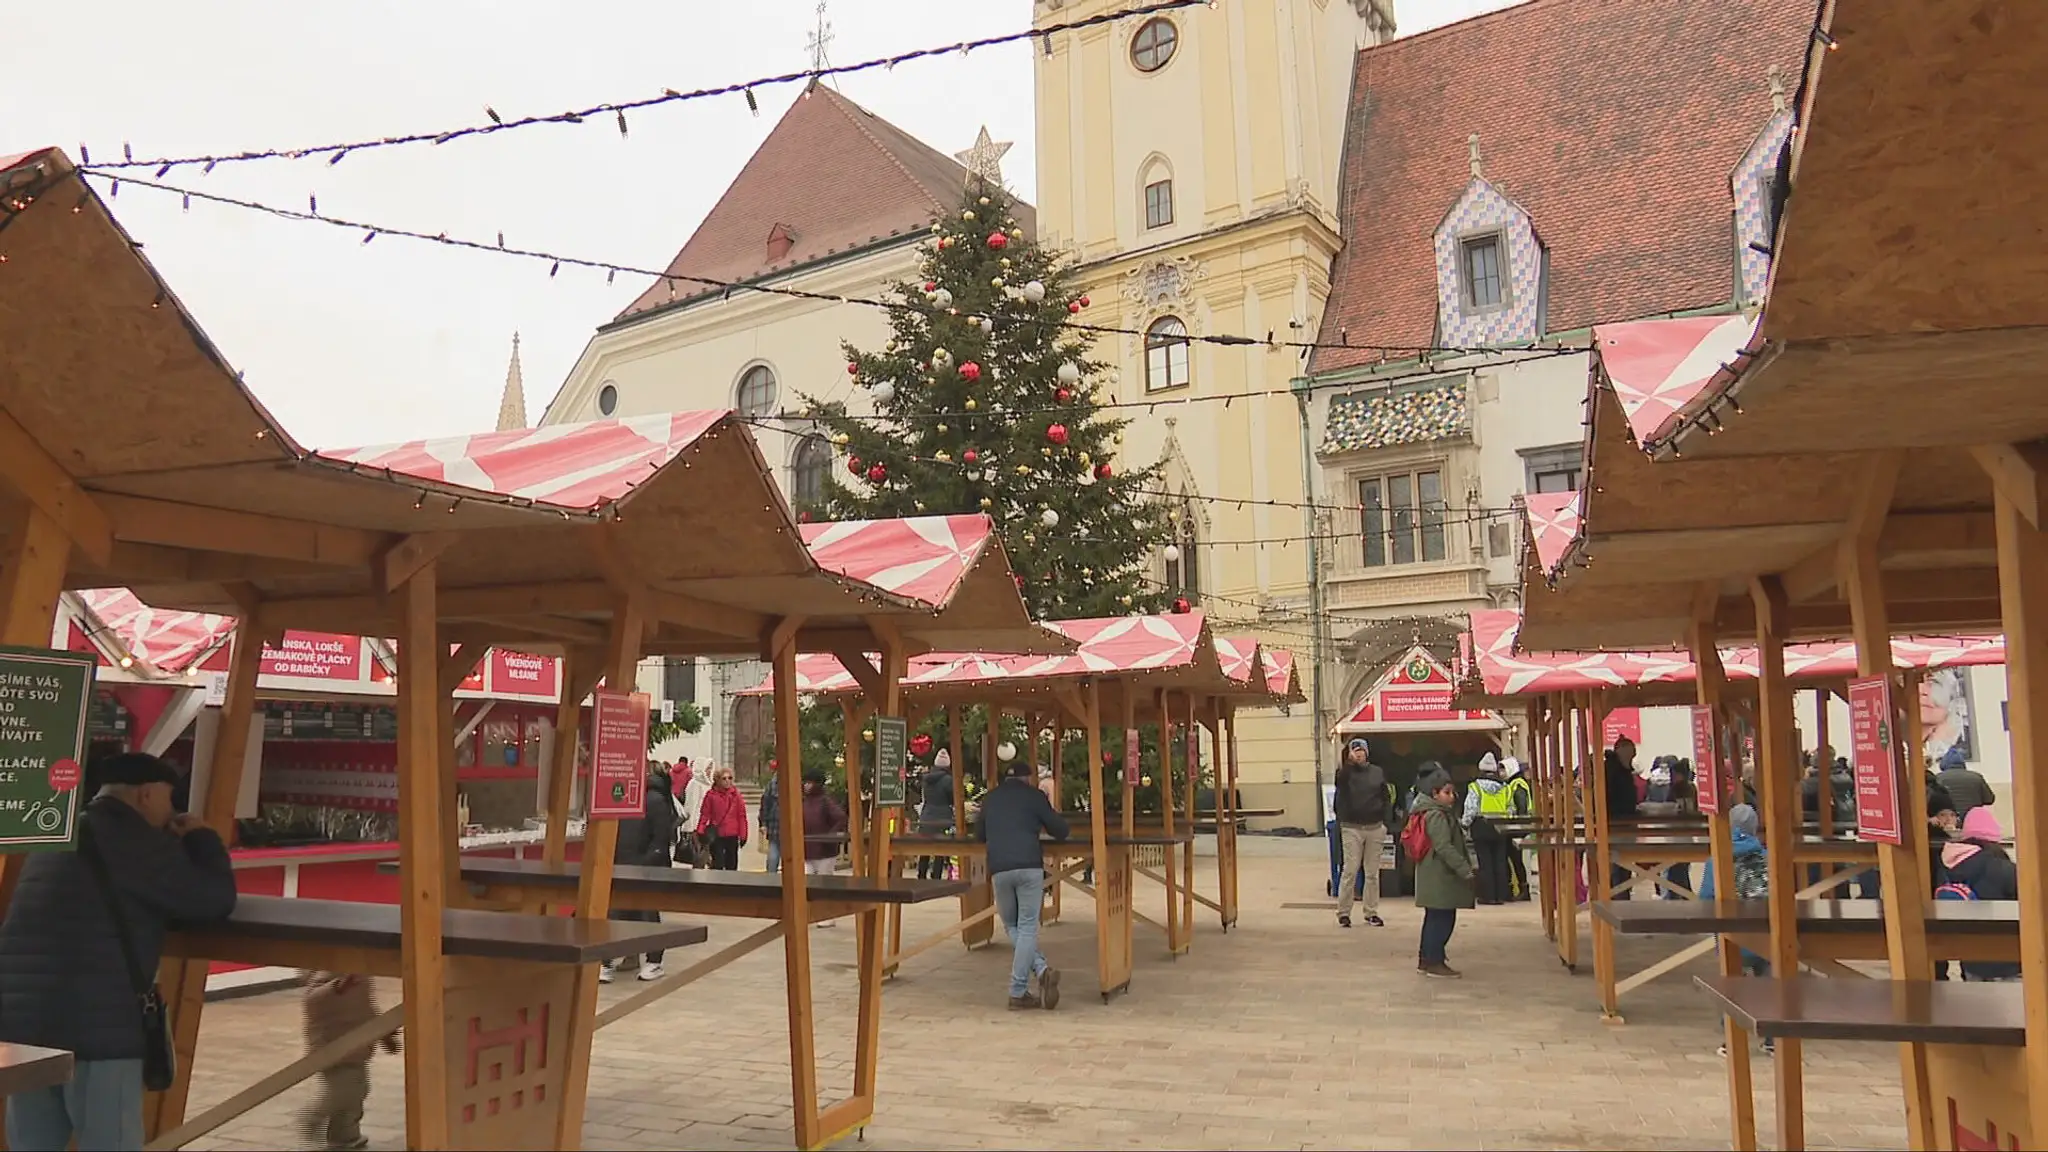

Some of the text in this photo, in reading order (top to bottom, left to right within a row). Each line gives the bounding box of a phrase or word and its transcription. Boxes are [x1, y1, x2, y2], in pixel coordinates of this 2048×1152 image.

[261, 650, 352, 665] ZEMIAKOVÉ PLACKY
[274, 662, 331, 675] OD BABIČKY
[36, 674, 63, 689] VÁS,
[29, 690, 59, 704] SVOJ
